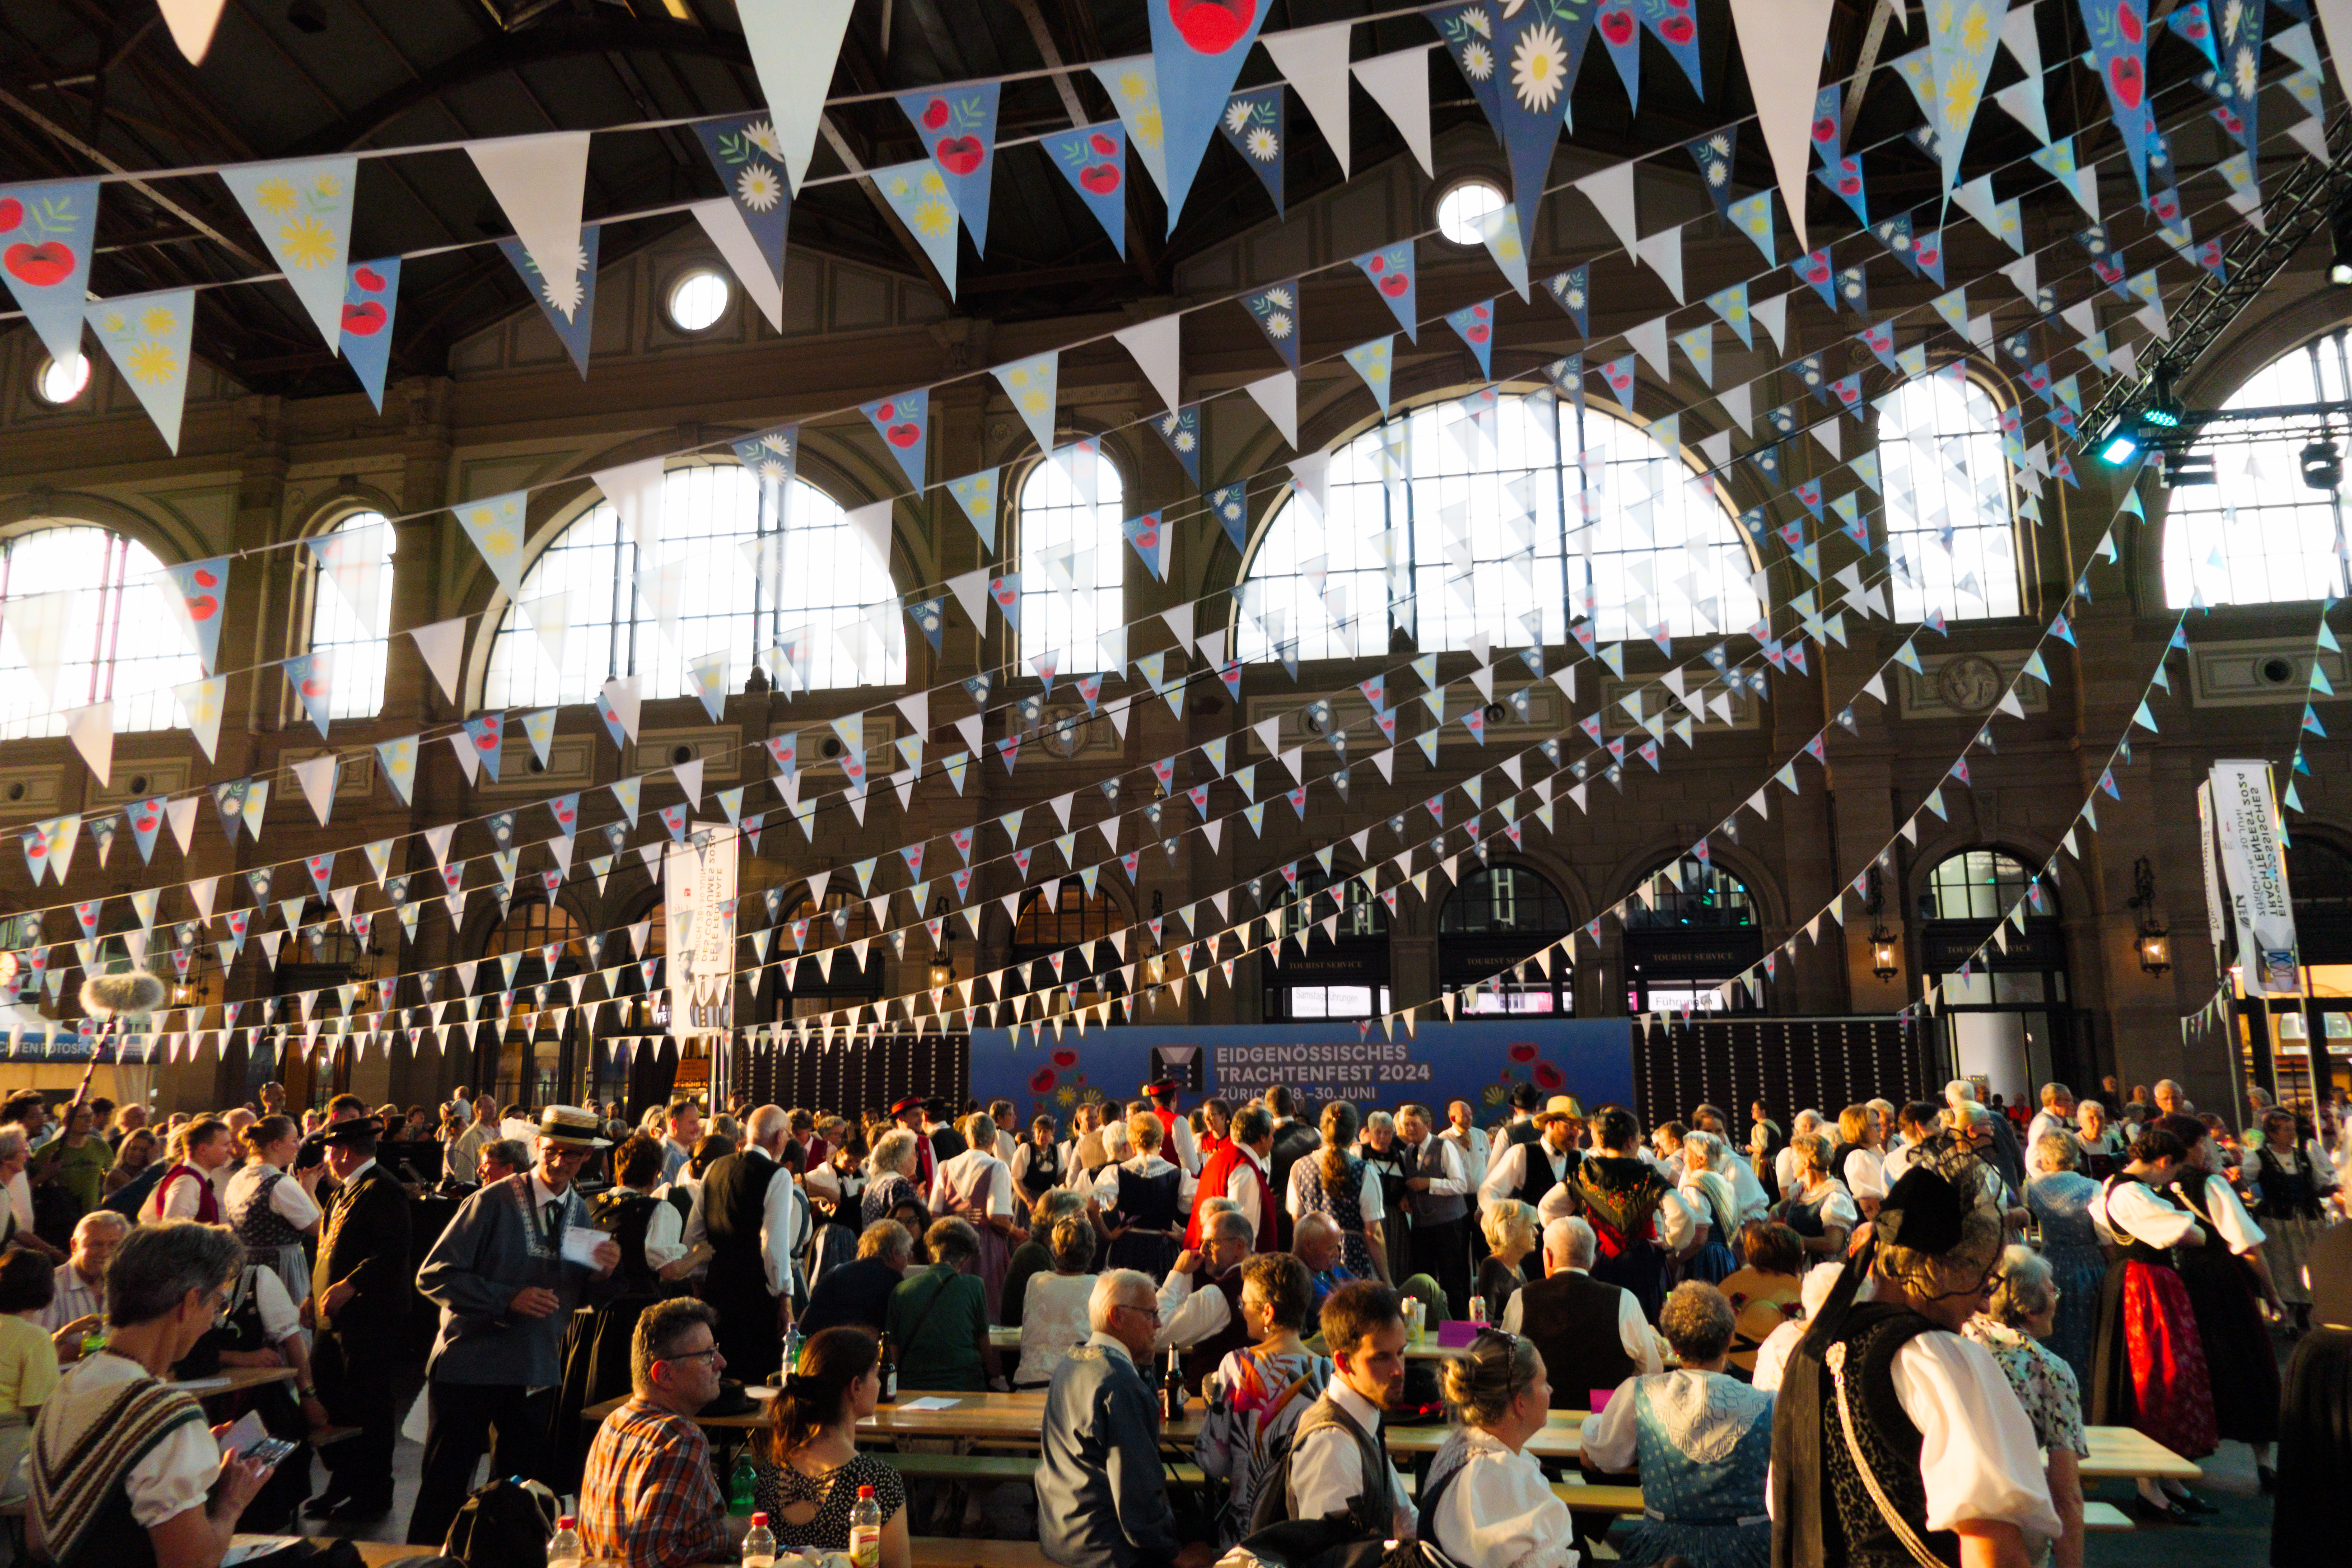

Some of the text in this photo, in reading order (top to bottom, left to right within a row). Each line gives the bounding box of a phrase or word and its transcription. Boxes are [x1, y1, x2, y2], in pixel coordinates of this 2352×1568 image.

[1694, 952, 1733, 960] SERVICE
[1289, 960, 1363, 970] TOURIST SERVICE
[1216, 1043, 1407, 1063] EIDGENÖSSISCHES
[1217, 1063, 1431, 1082] TRACHTENFEST 2024
[1218, 1085, 1266, 1101] ZÜRIC
